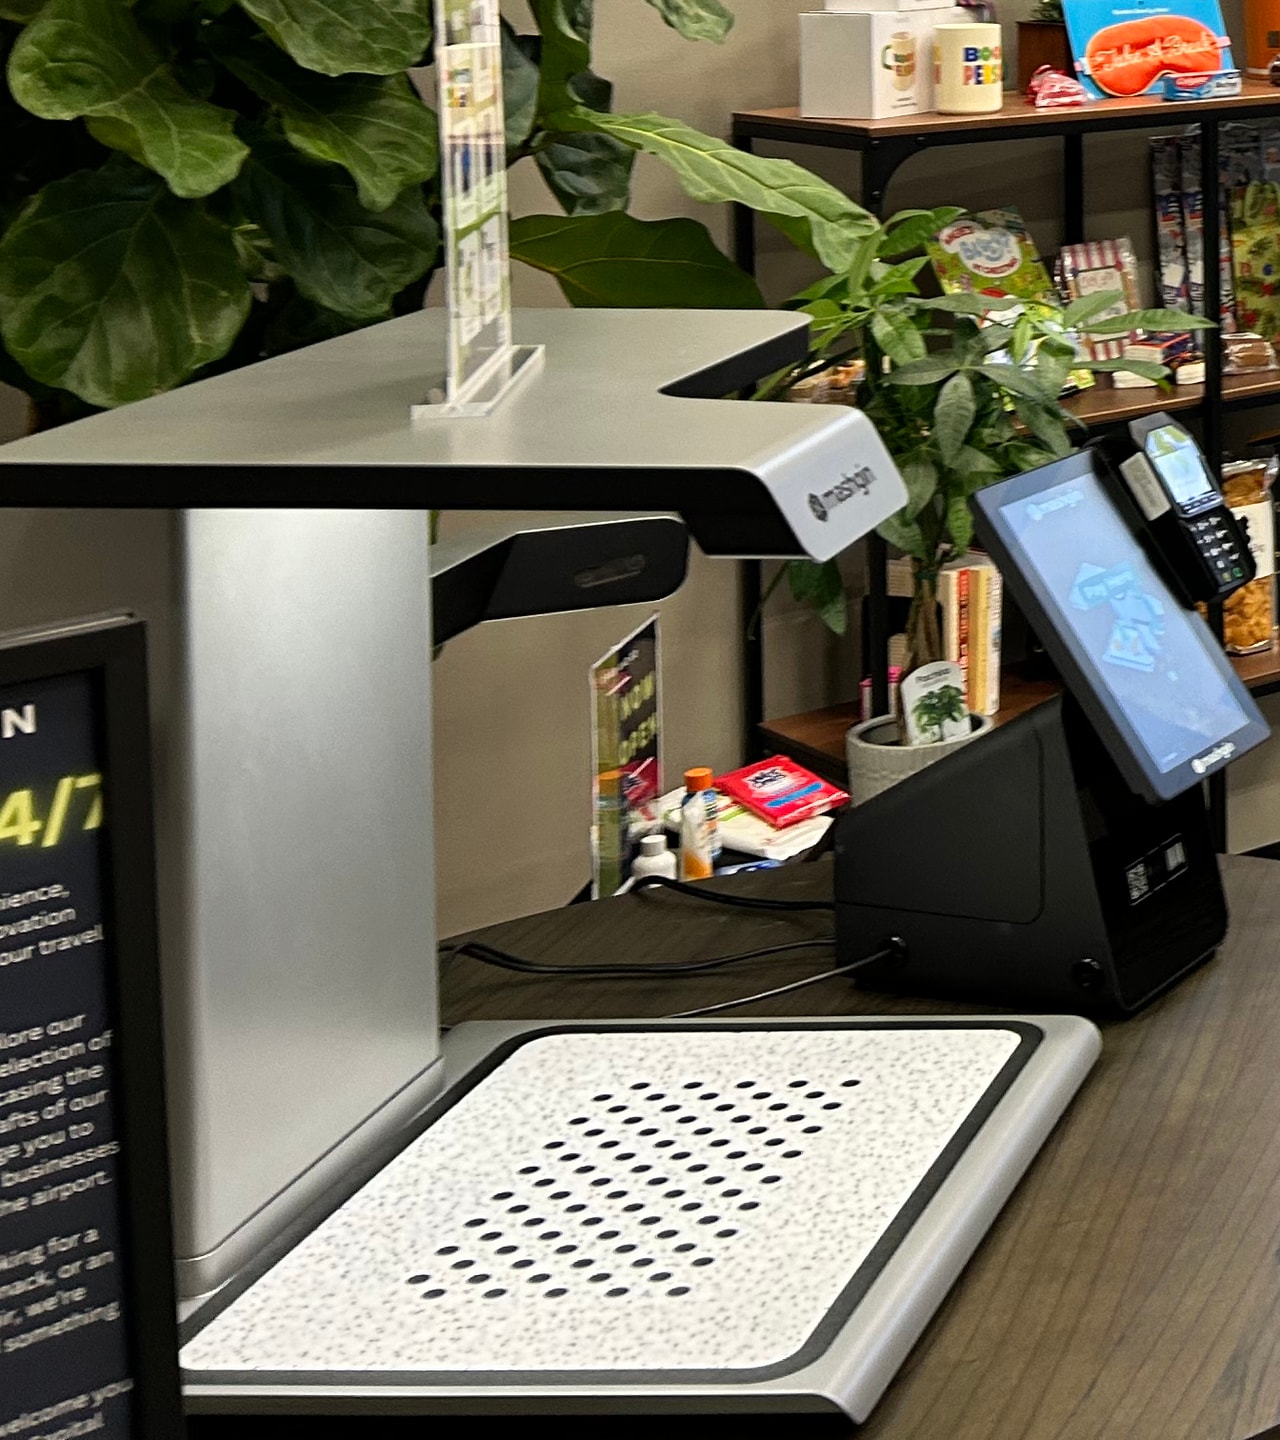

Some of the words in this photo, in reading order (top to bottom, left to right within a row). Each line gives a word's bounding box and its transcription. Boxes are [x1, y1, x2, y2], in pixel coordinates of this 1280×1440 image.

[2, 704, 36, 738] N
[38, 923, 104, 955] travel
[46, 1014, 86, 1035] our
[88, 1029, 113, 1051] of
[66, 1067, 105, 1085] the
[41, 1098, 67, 1120] of
[69, 1089, 109, 1111] our
[22, 1130, 66, 1158] you
[69, 1122, 94, 1139] to
[1, 1141, 120, 1187] businesses
[31, 1171, 112, 1206] airport.
[46, 1234, 81, 1254] for
[83, 1229, 100, 1243] a
[57, 1261, 83, 1279] or
[85, 1251, 114, 1270] an
[25, 1288, 88, 1317] we're
[90, 1379, 134, 1408] you
